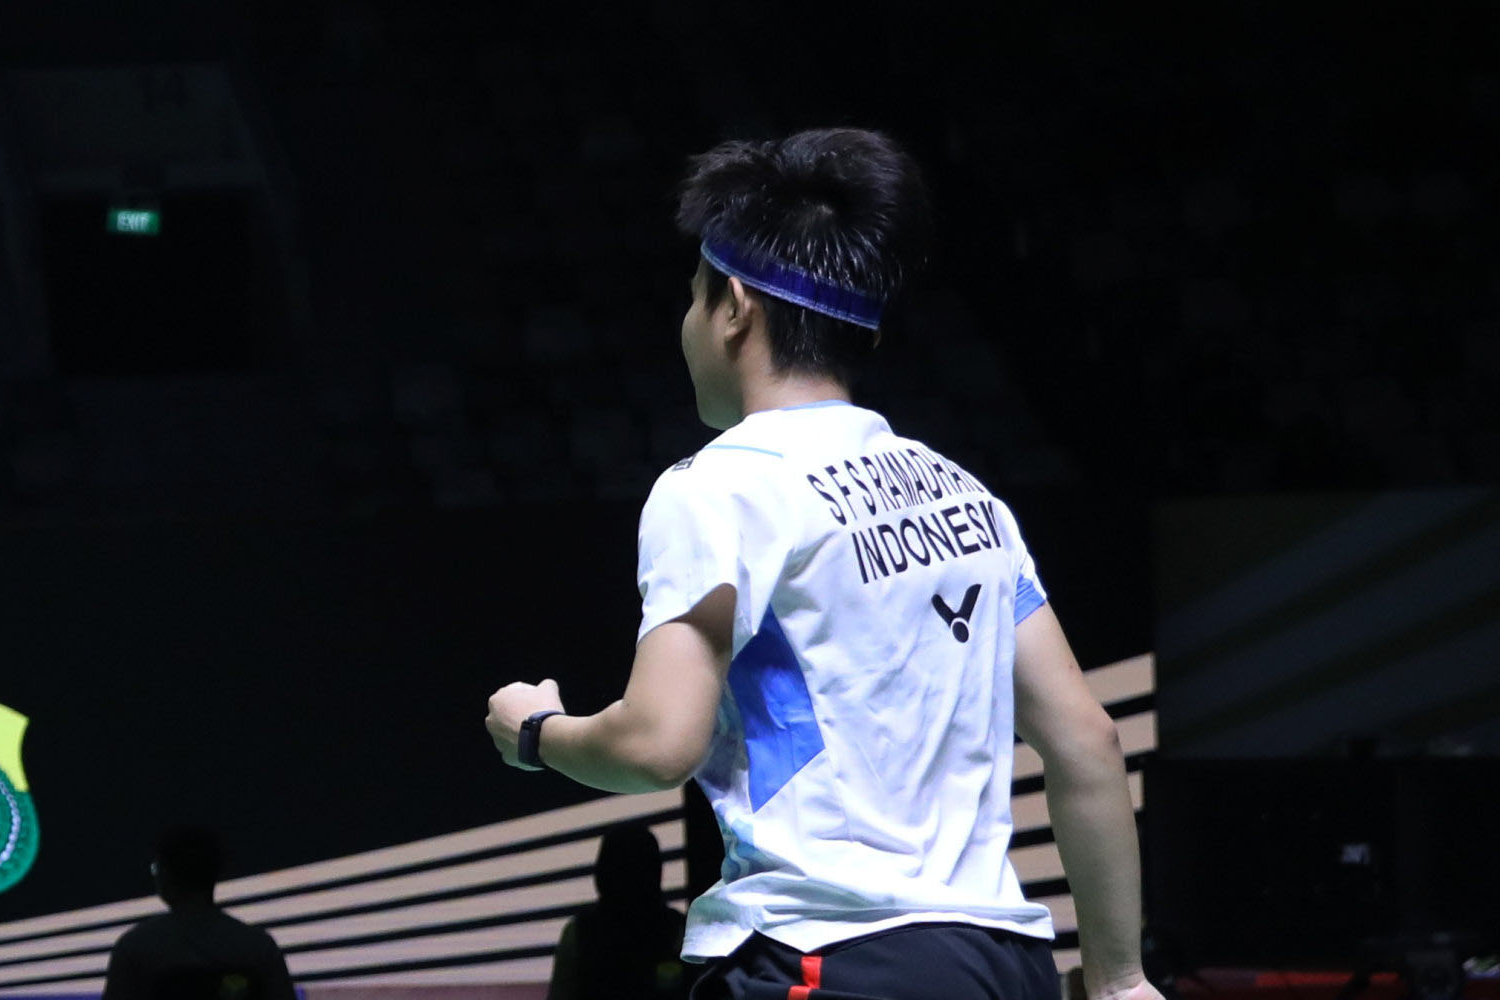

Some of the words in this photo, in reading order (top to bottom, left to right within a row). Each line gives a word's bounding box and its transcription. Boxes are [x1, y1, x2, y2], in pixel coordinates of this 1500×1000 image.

[806, 474, 847, 526] S
[824, 465, 858, 521] F
[844, 460, 877, 516] S
[852, 500, 1001, 584] INDONESI
